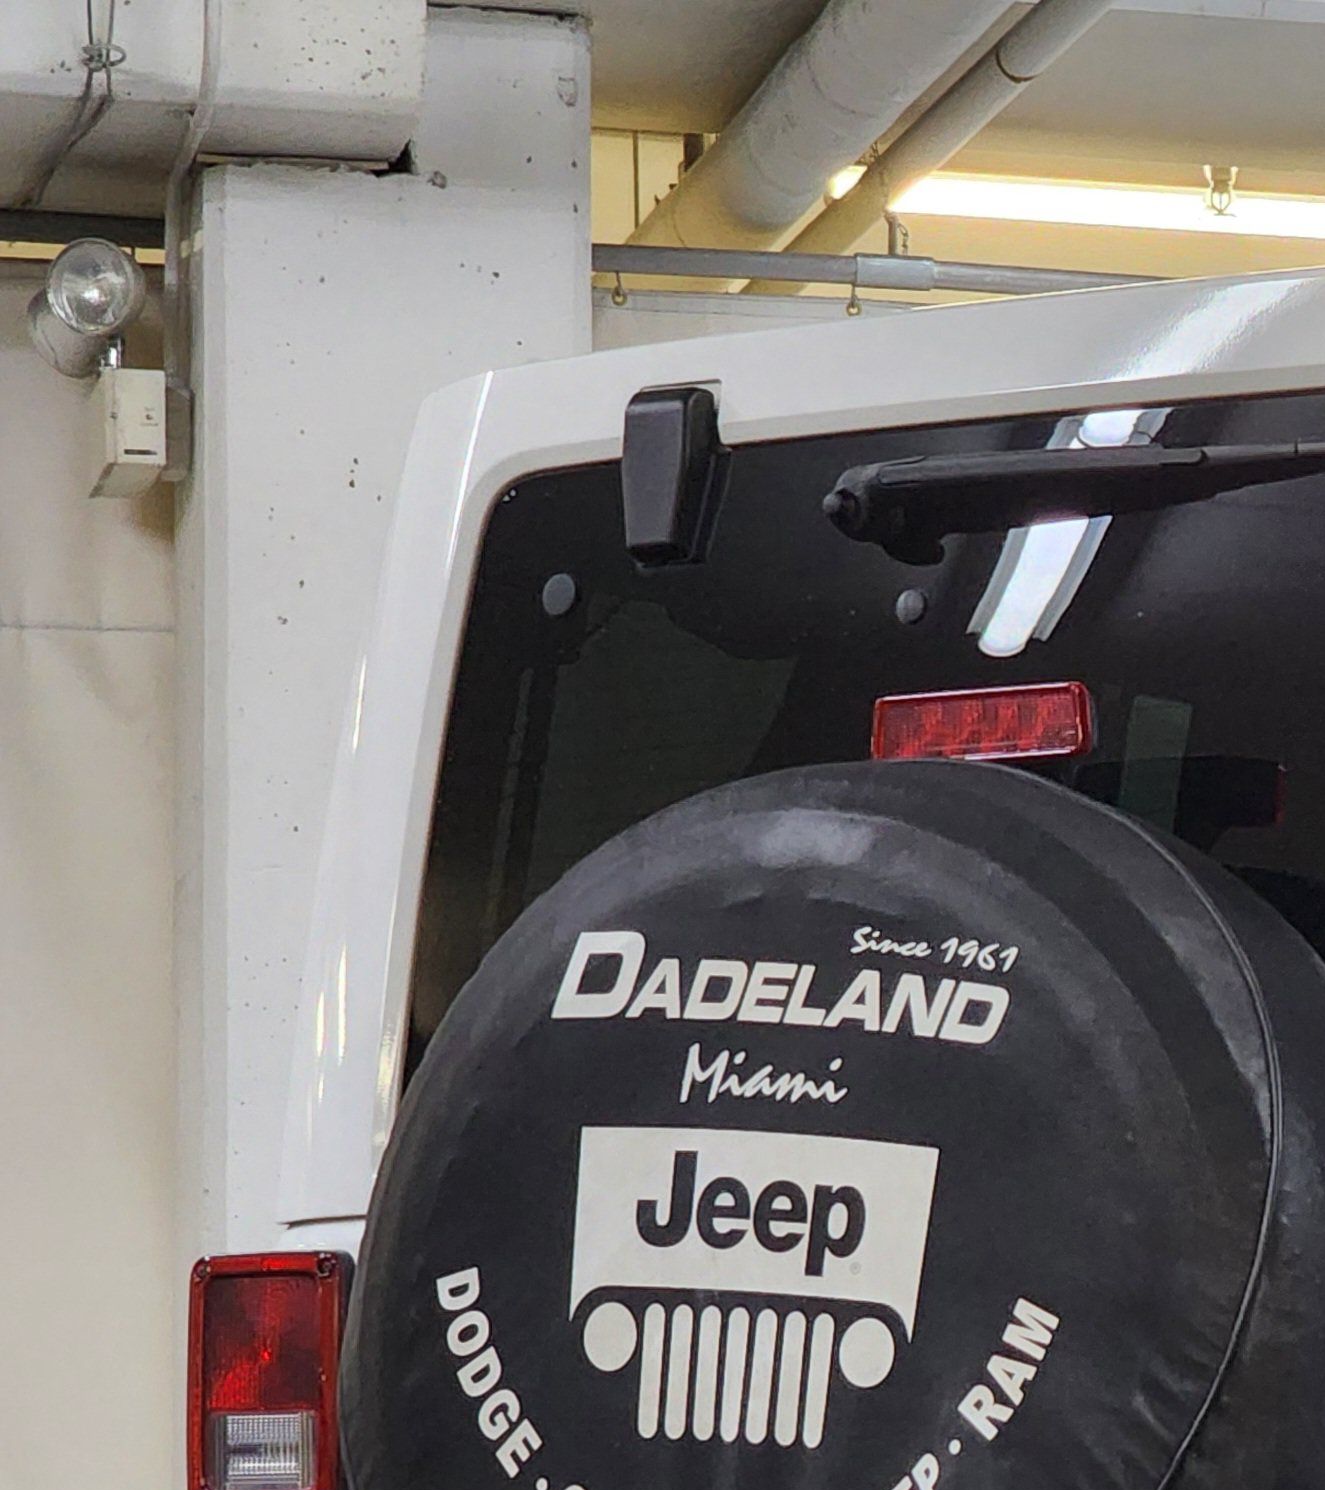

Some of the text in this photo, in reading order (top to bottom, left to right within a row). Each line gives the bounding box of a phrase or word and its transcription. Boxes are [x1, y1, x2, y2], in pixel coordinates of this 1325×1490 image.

[551, 930, 1010, 1044] DADELAND
[850, 926, 1019, 973] Since 1961
[680, 1043, 848, 1103] Miami
[636, 1150, 866, 1277] Jeep
[436, 1267, 542, 1478] DODGE
[957, 1298, 1060, 1441] RAM
